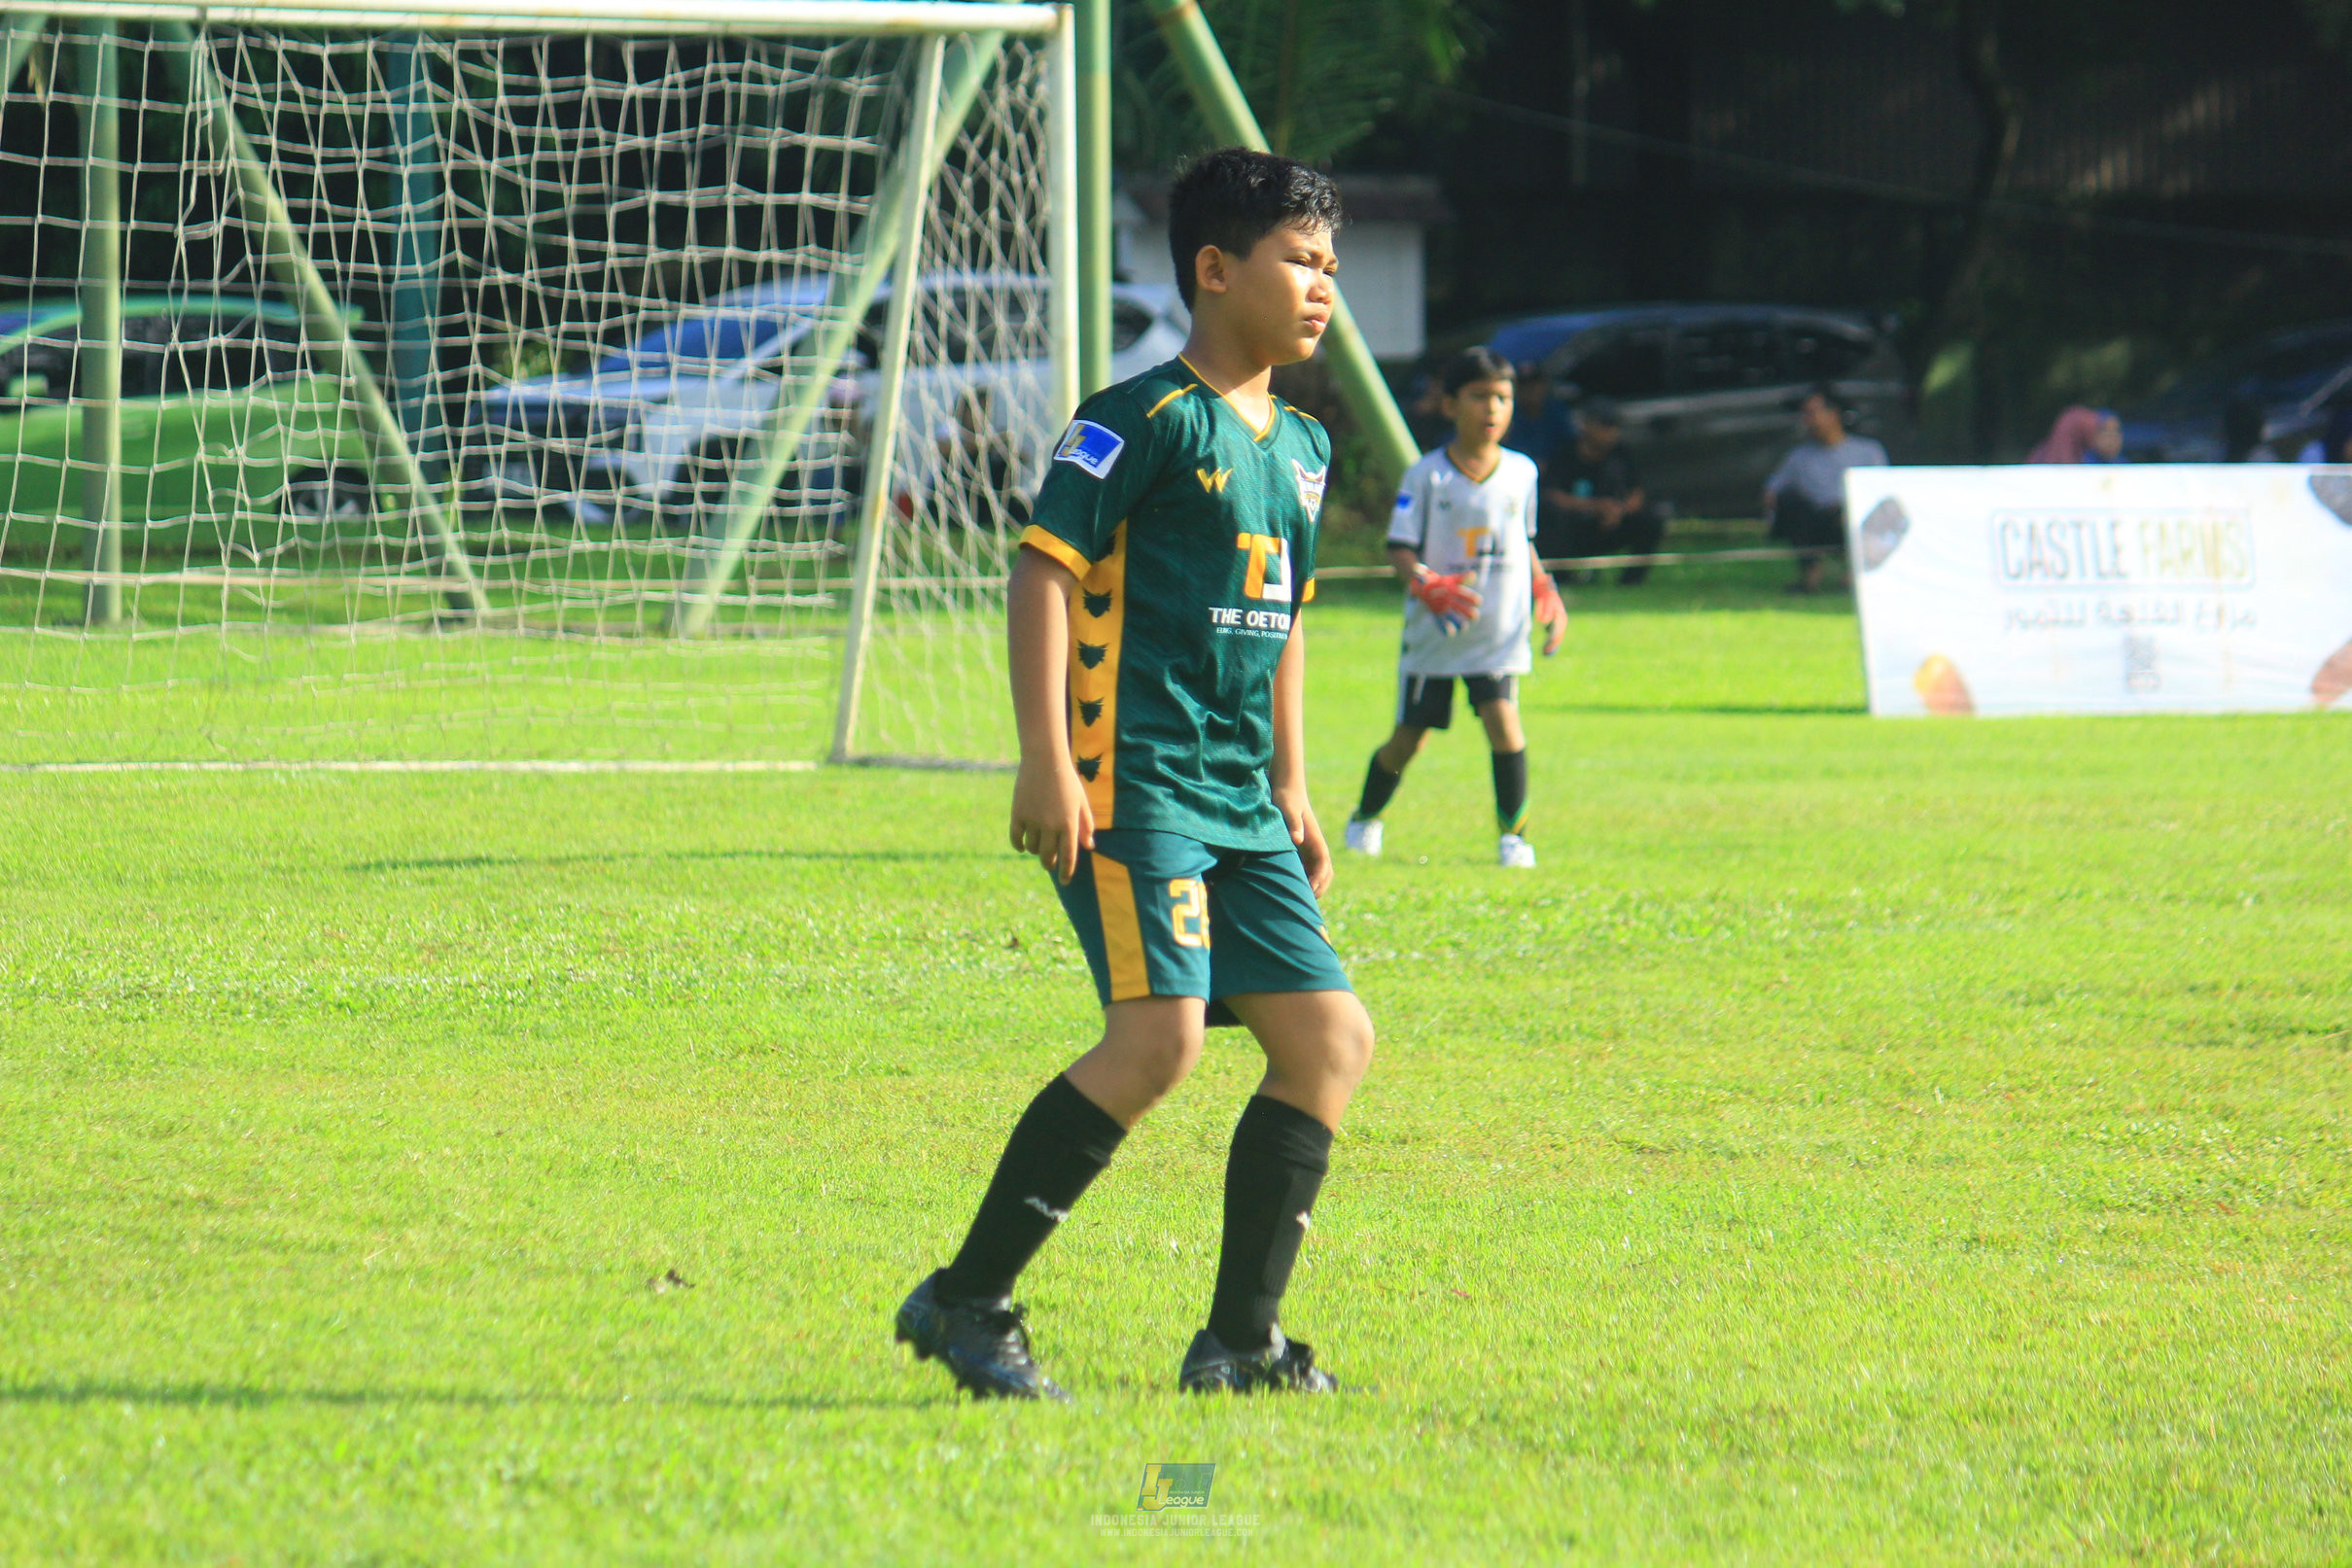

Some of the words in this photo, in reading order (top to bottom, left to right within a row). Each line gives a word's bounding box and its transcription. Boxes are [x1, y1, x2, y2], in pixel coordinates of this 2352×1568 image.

[1999, 518, 2130, 580] CASTLE
[2137, 518, 2246, 580] FARMS
[1209, 607, 1243, 625] THE
[1246, 610, 1291, 631] OETO
